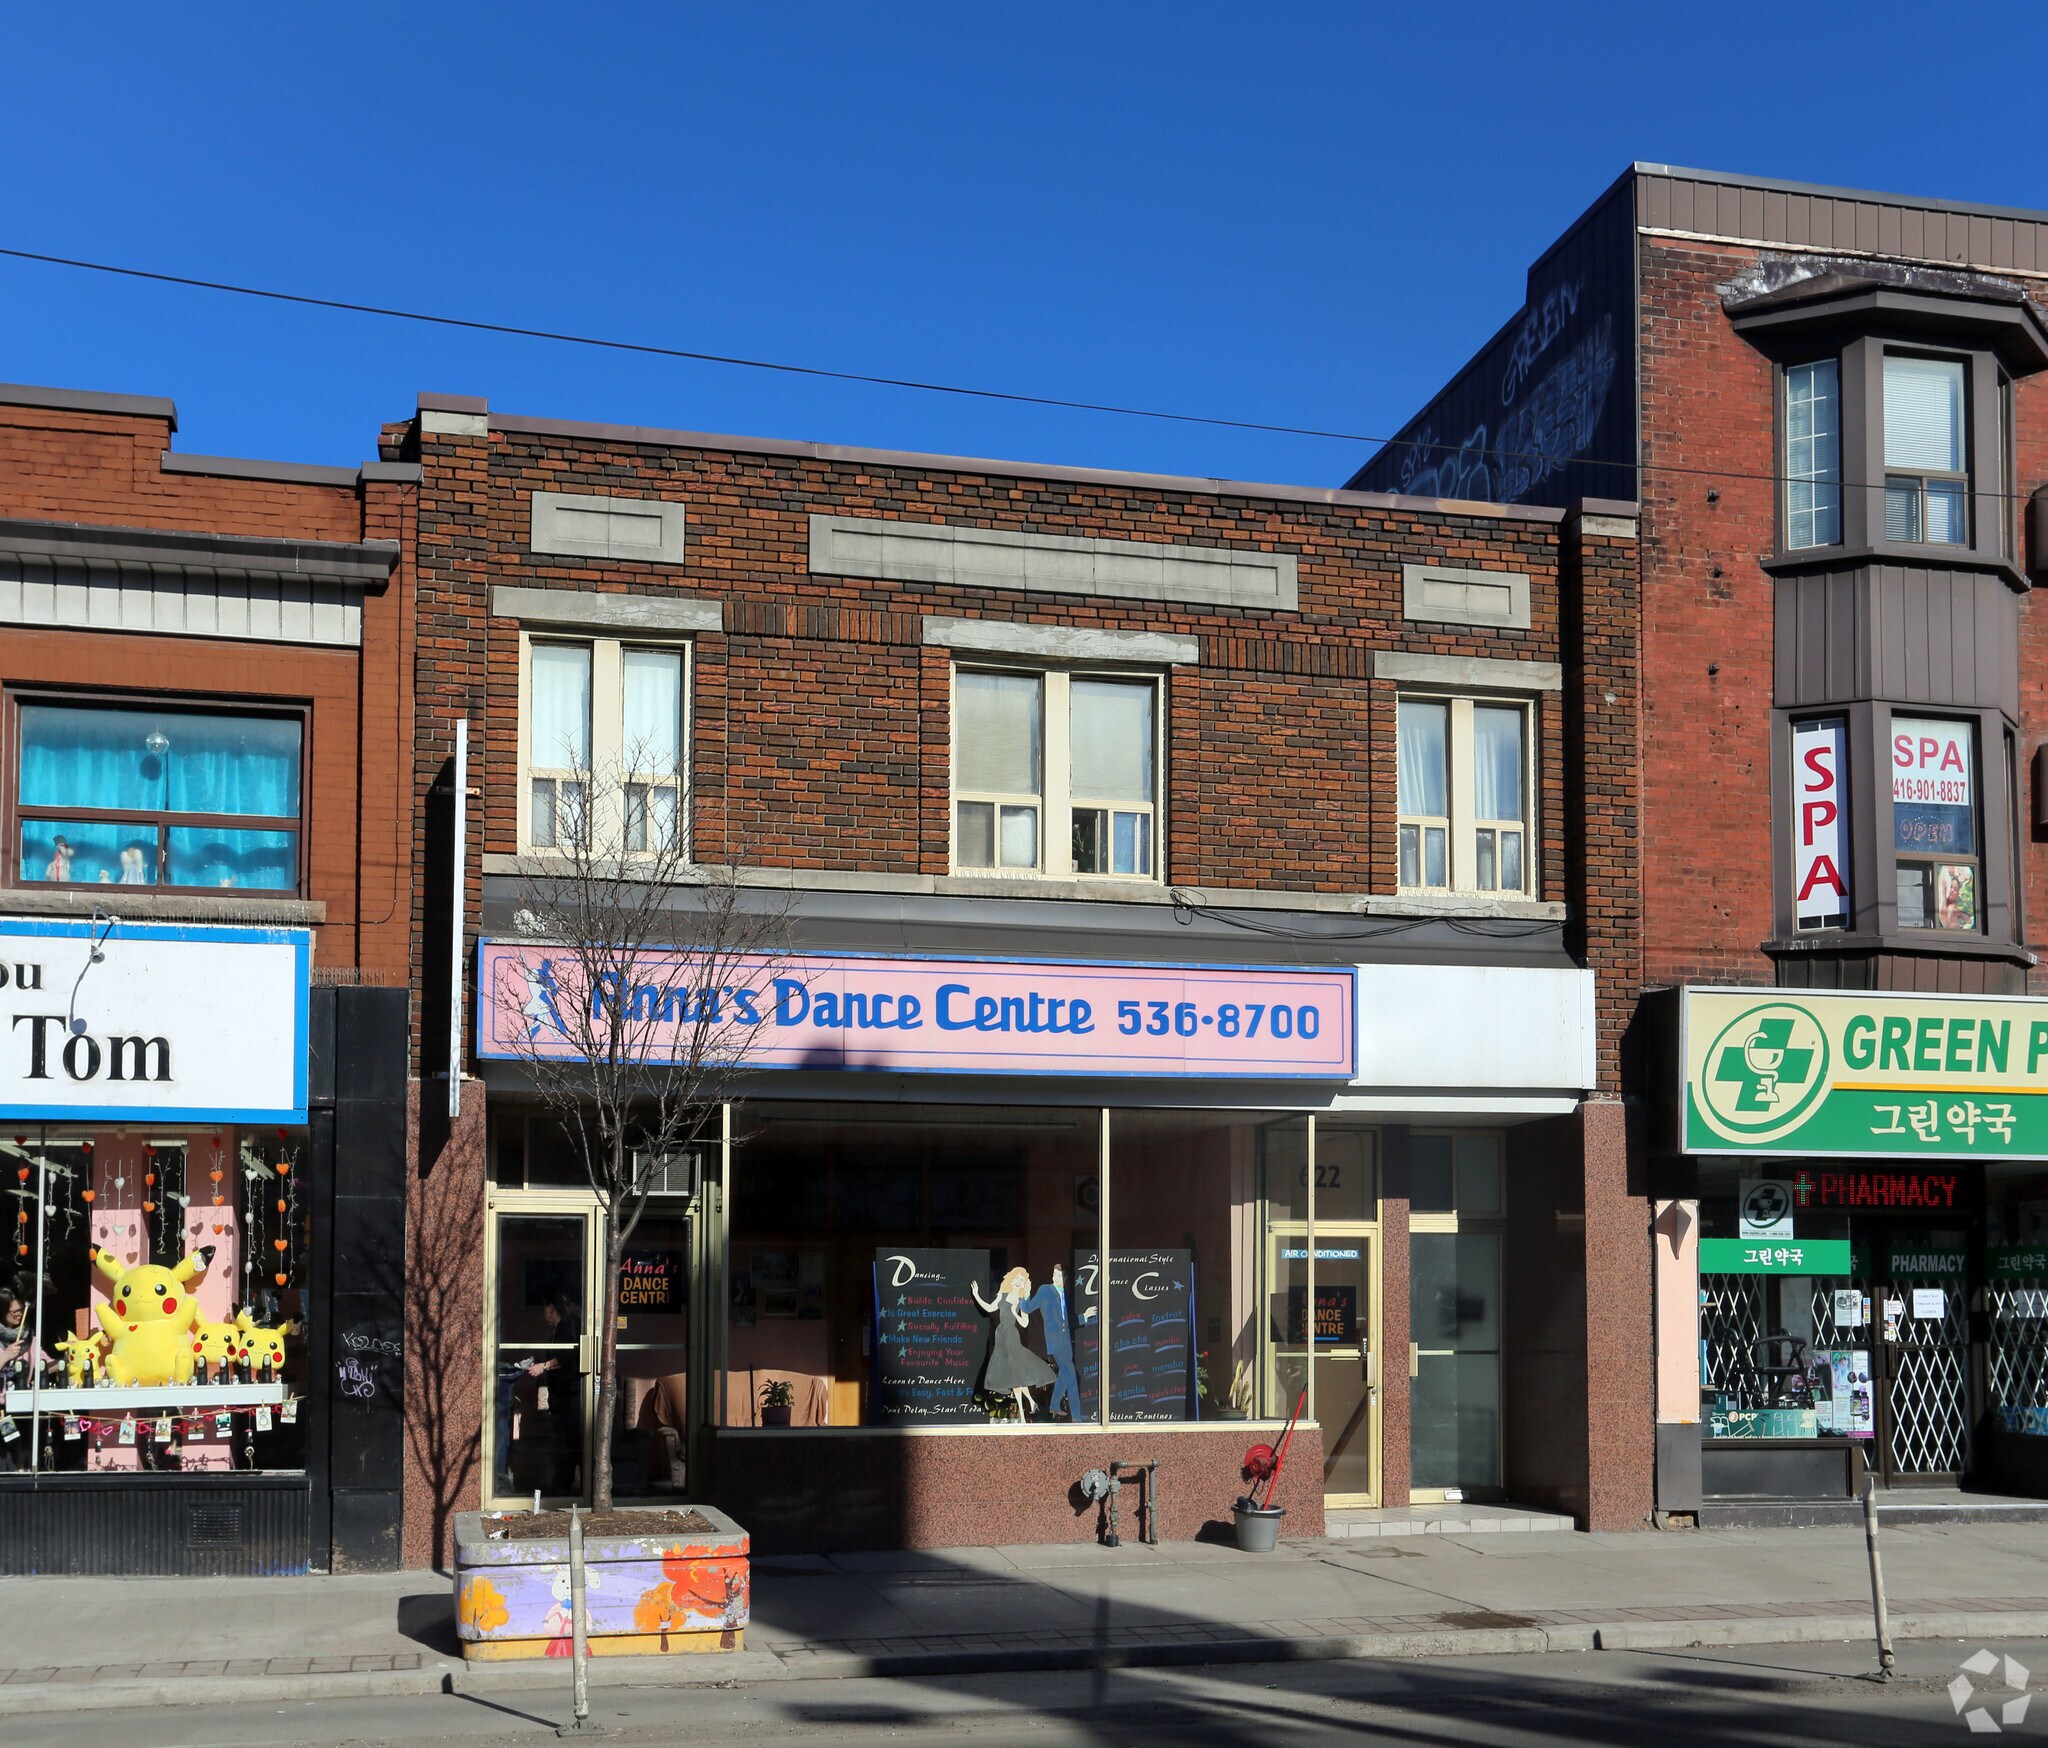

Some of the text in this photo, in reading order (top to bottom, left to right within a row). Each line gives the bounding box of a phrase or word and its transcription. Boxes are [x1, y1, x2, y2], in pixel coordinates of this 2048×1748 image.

[1894, 734, 1964, 773] SPA
[1893, 777, 1966, 802] 416-901-8837
[1798, 746, 1849, 901] SPA
[1899, 818, 1953, 842] OPEN
[592, 971, 761, 1025] Anna's
[772, 978, 922, 1031] Dance
[935, 983, 1096, 1035] Centre
[12, 1015, 174, 1081] Tom
[1843, 1014, 2012, 1074] GREEN
[1821, 1174, 1956, 1206] PHARMACY
[1148, 1253, 1175, 1265] Style
[1284, 1249, 1299, 1258] AIR
[1891, 1254, 1965, 1273] PHARMACY
[623, 1277, 669, 1290] DANCE
[1131, 1271, 1170, 1300] Classes
[620, 1291, 670, 1304] CENTR
[907, 1296, 932, 1305] Builds
[897, 1308, 919, 1317] Great
[922, 1308, 957, 1317] Exercise
[1151, 1309, 1182, 1322] foxtrot
[1302, 1309, 1342, 1321] DNCE
[907, 1322, 978, 1333] Socially Fulfilling
[888, 1334, 963, 1343] Make New Friends
[1132, 1335, 1148, 1345] cha
[908, 1347, 964, 1358] Enjoying Your
[900, 1359, 969, 1367] Favourite Music
[1151, 1360, 1184, 1373] mambo
[882, 1375, 966, 1384] Learn to Dance Here
[936, 1387, 954, 1397] Fast
[956, 1387, 965, 1397] &
[959, 1403, 985, 1414] Toda
[1135, 1411, 1173, 1420] Routines
[1739, 1413, 1757, 1421] PCP
